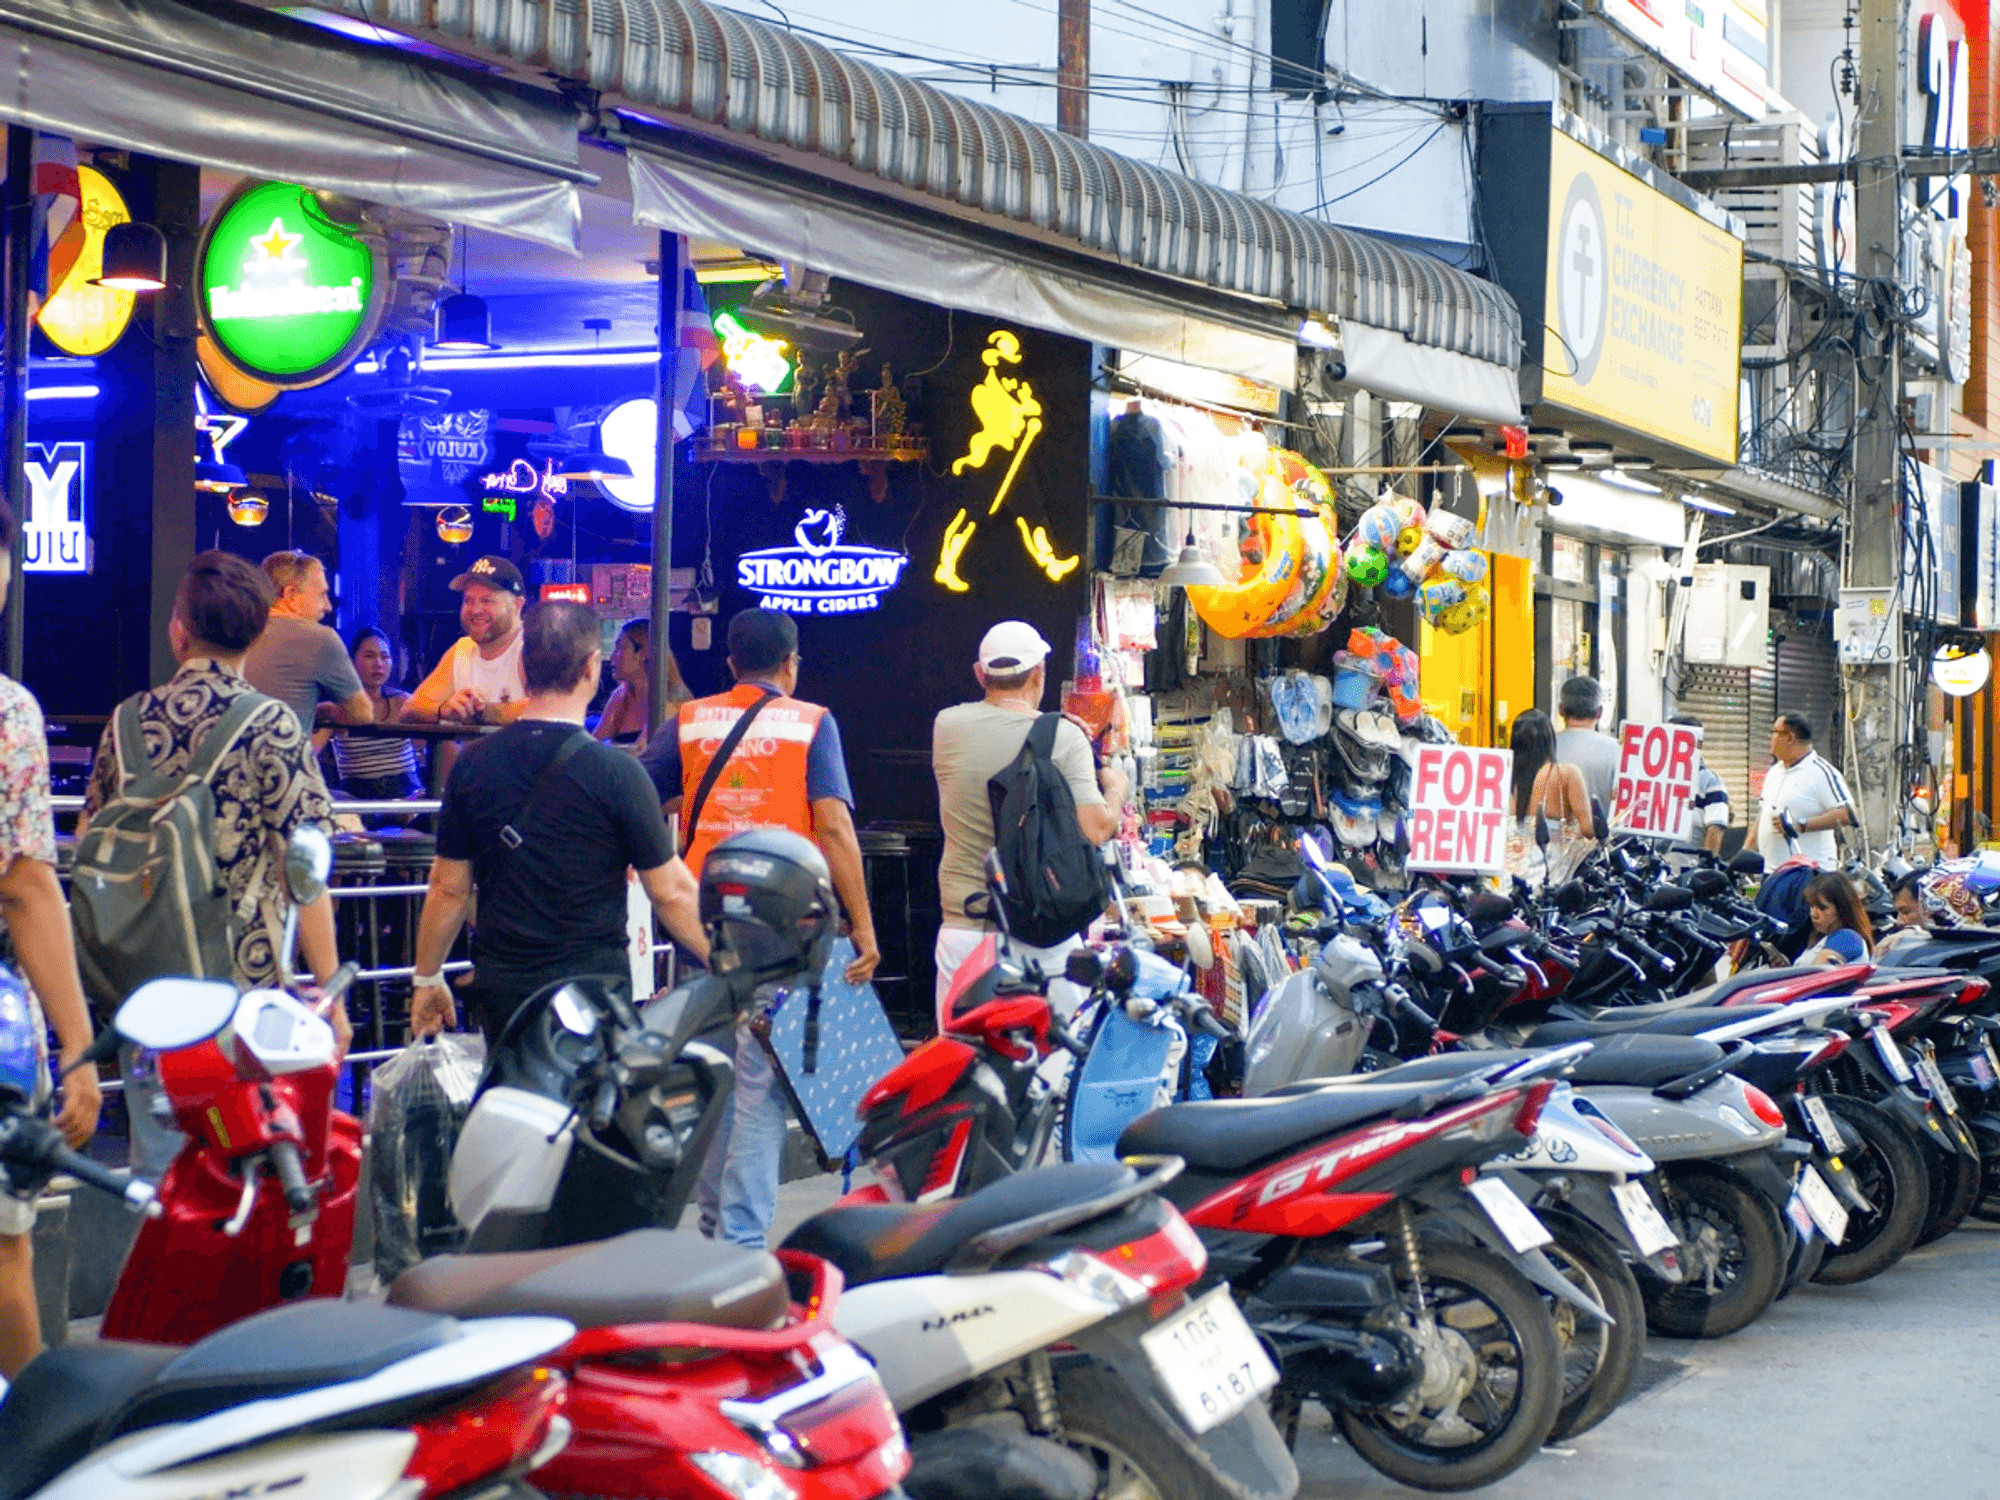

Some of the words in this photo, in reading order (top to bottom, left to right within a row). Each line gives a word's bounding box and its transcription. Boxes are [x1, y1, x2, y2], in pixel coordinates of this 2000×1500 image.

[1612, 243, 1685, 315] CURRENCY
[1610, 293, 1685, 366] EXCHANGE
[738, 556, 902, 586] STRONGBOW
[760, 594, 812, 613] APPLE
[816, 593, 878, 613] CIDERS
[1415, 748, 1505, 809] FOR
[1620, 723, 1696, 782] FOR
[1615, 776, 1691, 834] RENT
[1410, 808, 1503, 864] RENT
[1200, 1361, 1256, 1414] 6187
